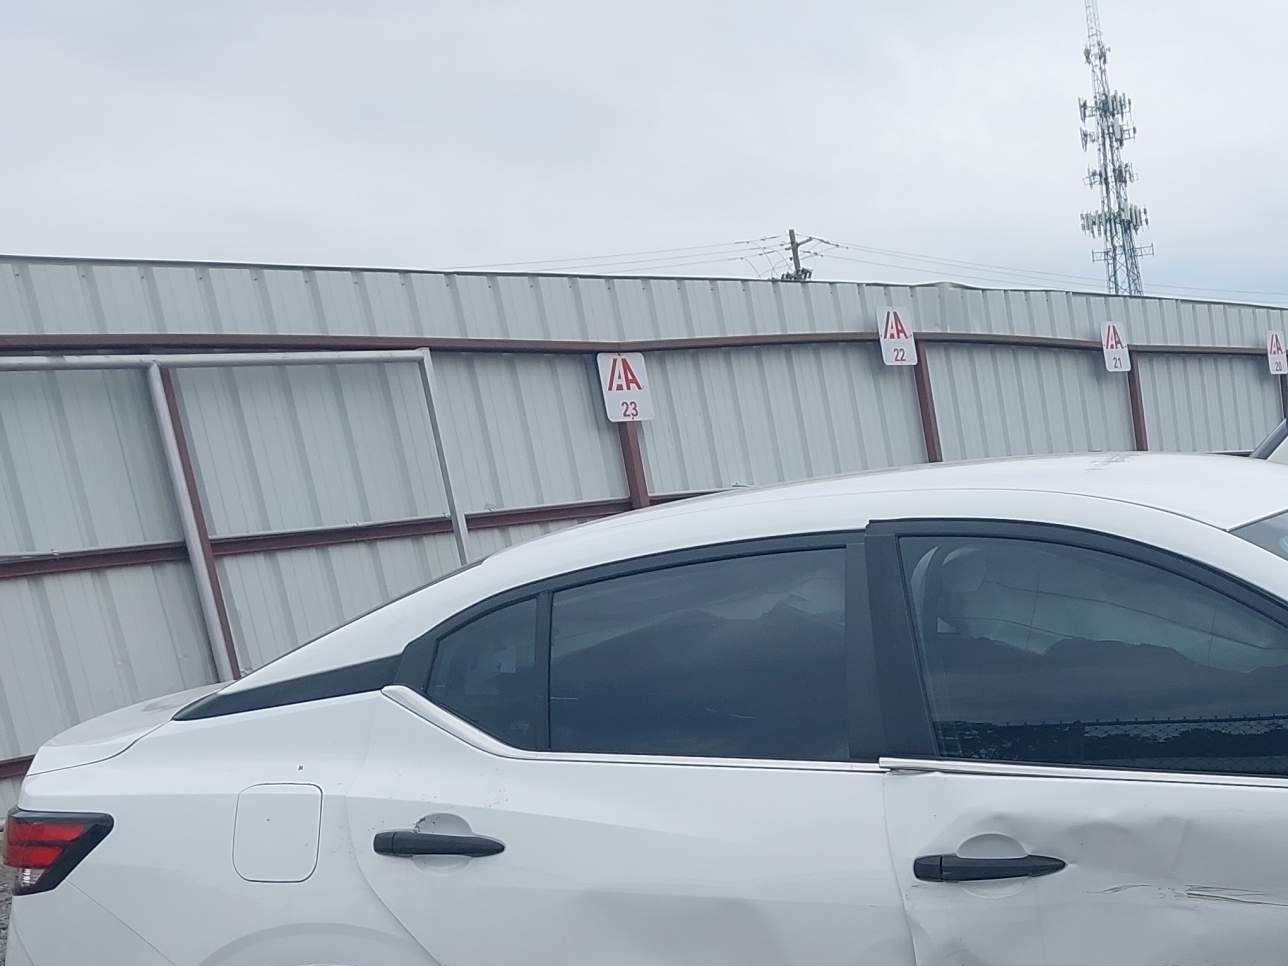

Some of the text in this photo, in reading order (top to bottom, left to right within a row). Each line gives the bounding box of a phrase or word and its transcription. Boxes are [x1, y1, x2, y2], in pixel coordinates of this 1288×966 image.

[894, 348, 906, 361] 22
[1113, 357, 1122, 368] 21
[622, 401, 638, 417] 23
